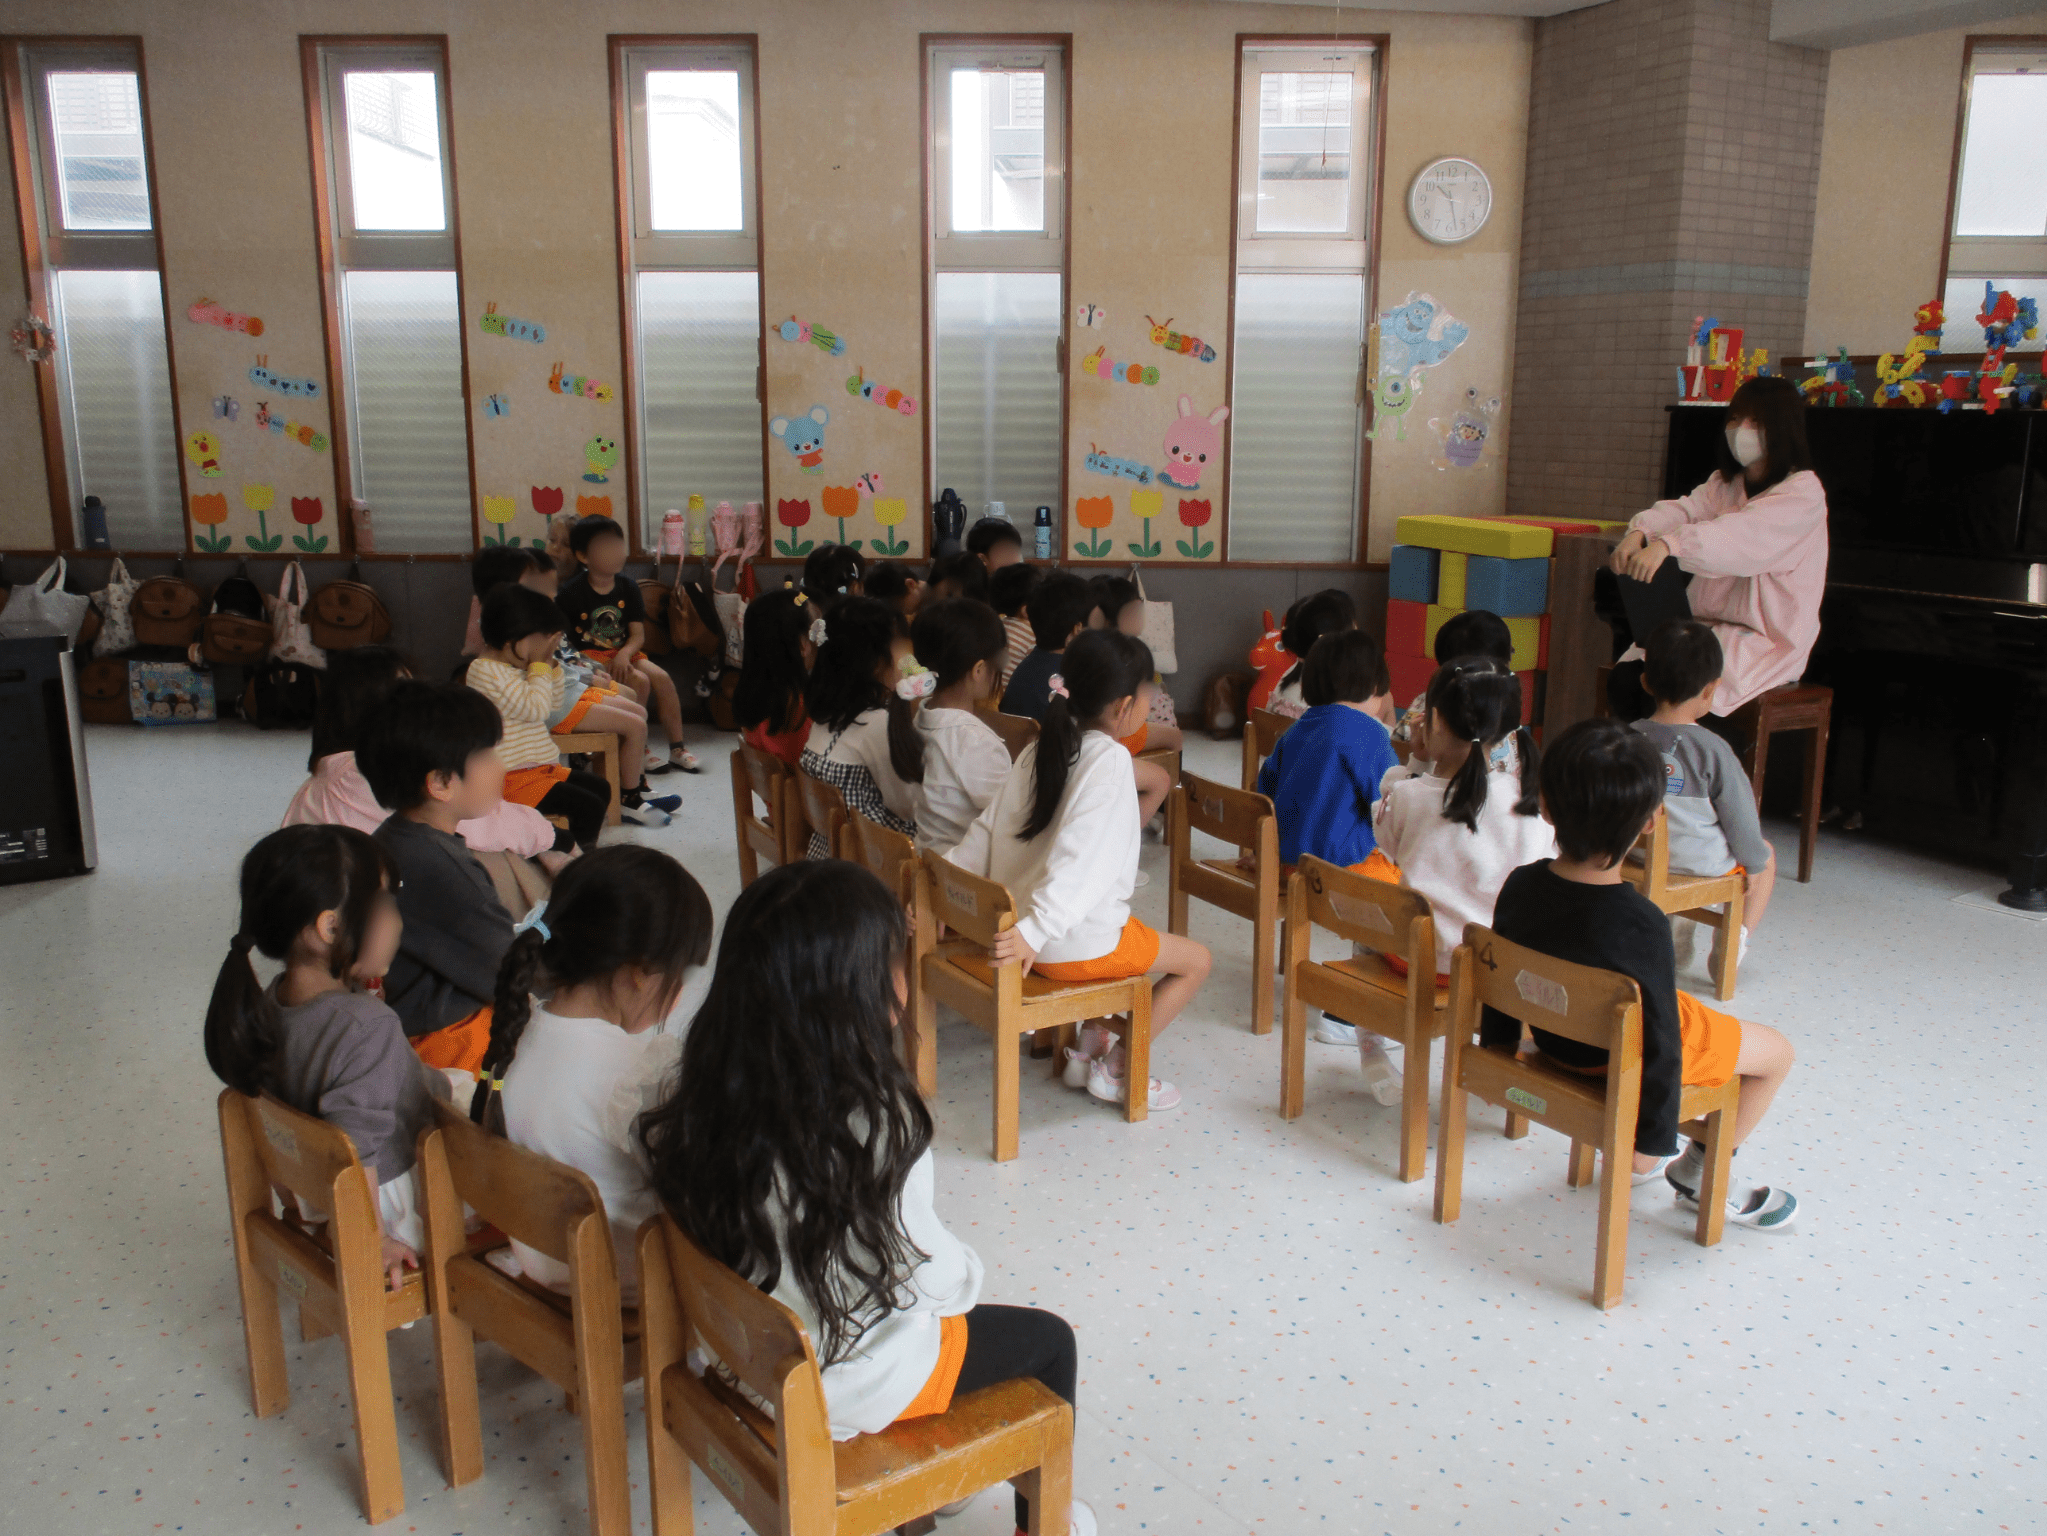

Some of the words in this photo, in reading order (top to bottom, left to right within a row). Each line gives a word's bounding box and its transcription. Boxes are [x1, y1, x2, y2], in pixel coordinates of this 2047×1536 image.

[1436, 171, 1445, 182] 11
[1448, 167, 1458, 178] 12
[1425, 181, 1435, 192] 10
[1471, 181, 1478, 192] 2
[1420, 194, 1427, 206] 9
[1475, 194, 1482, 207] 3
[1423, 208, 1431, 220] 8
[1468, 210, 1475, 221] 4
[1434, 218, 1441, 230] 7
[1445, 222, 1453, 234] 6
[1479, 942, 1498, 971] 4
